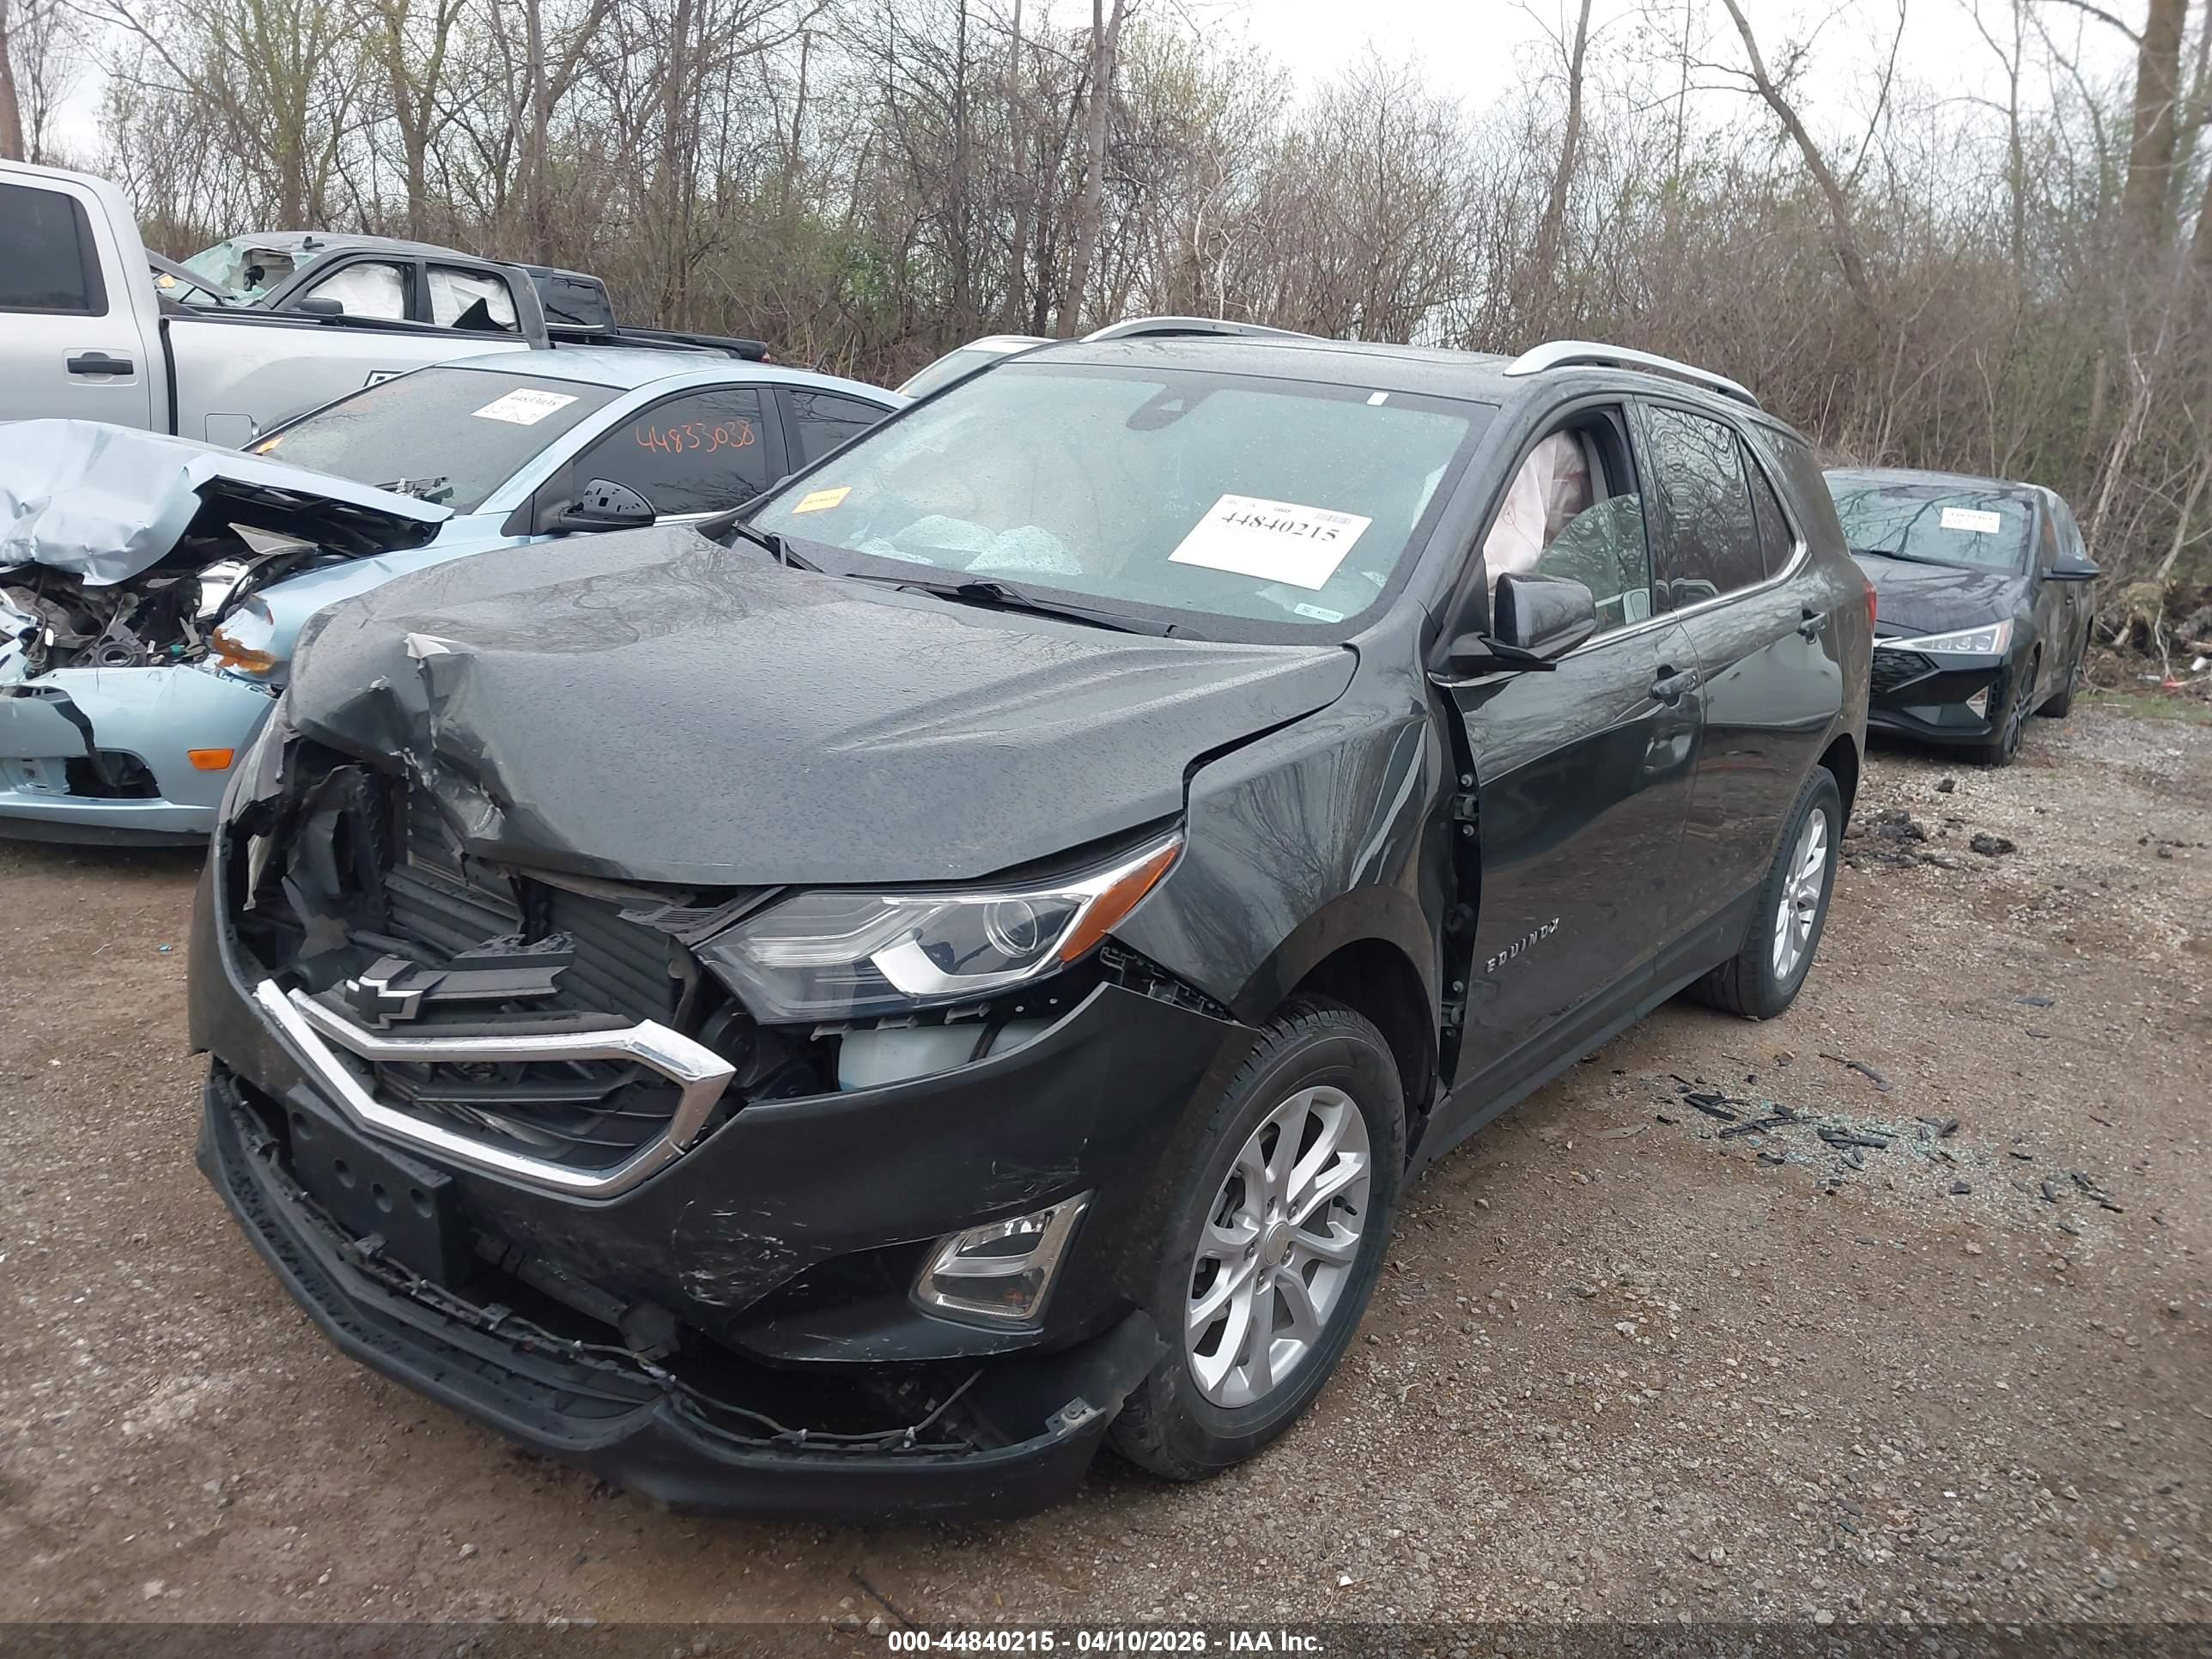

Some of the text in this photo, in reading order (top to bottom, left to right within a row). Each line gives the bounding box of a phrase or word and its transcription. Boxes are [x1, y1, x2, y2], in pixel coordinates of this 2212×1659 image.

[635, 419, 756, 453] 44833038
[1221, 511, 1340, 542] 44840215
[1486, 916, 1560, 974] EQUINOX
